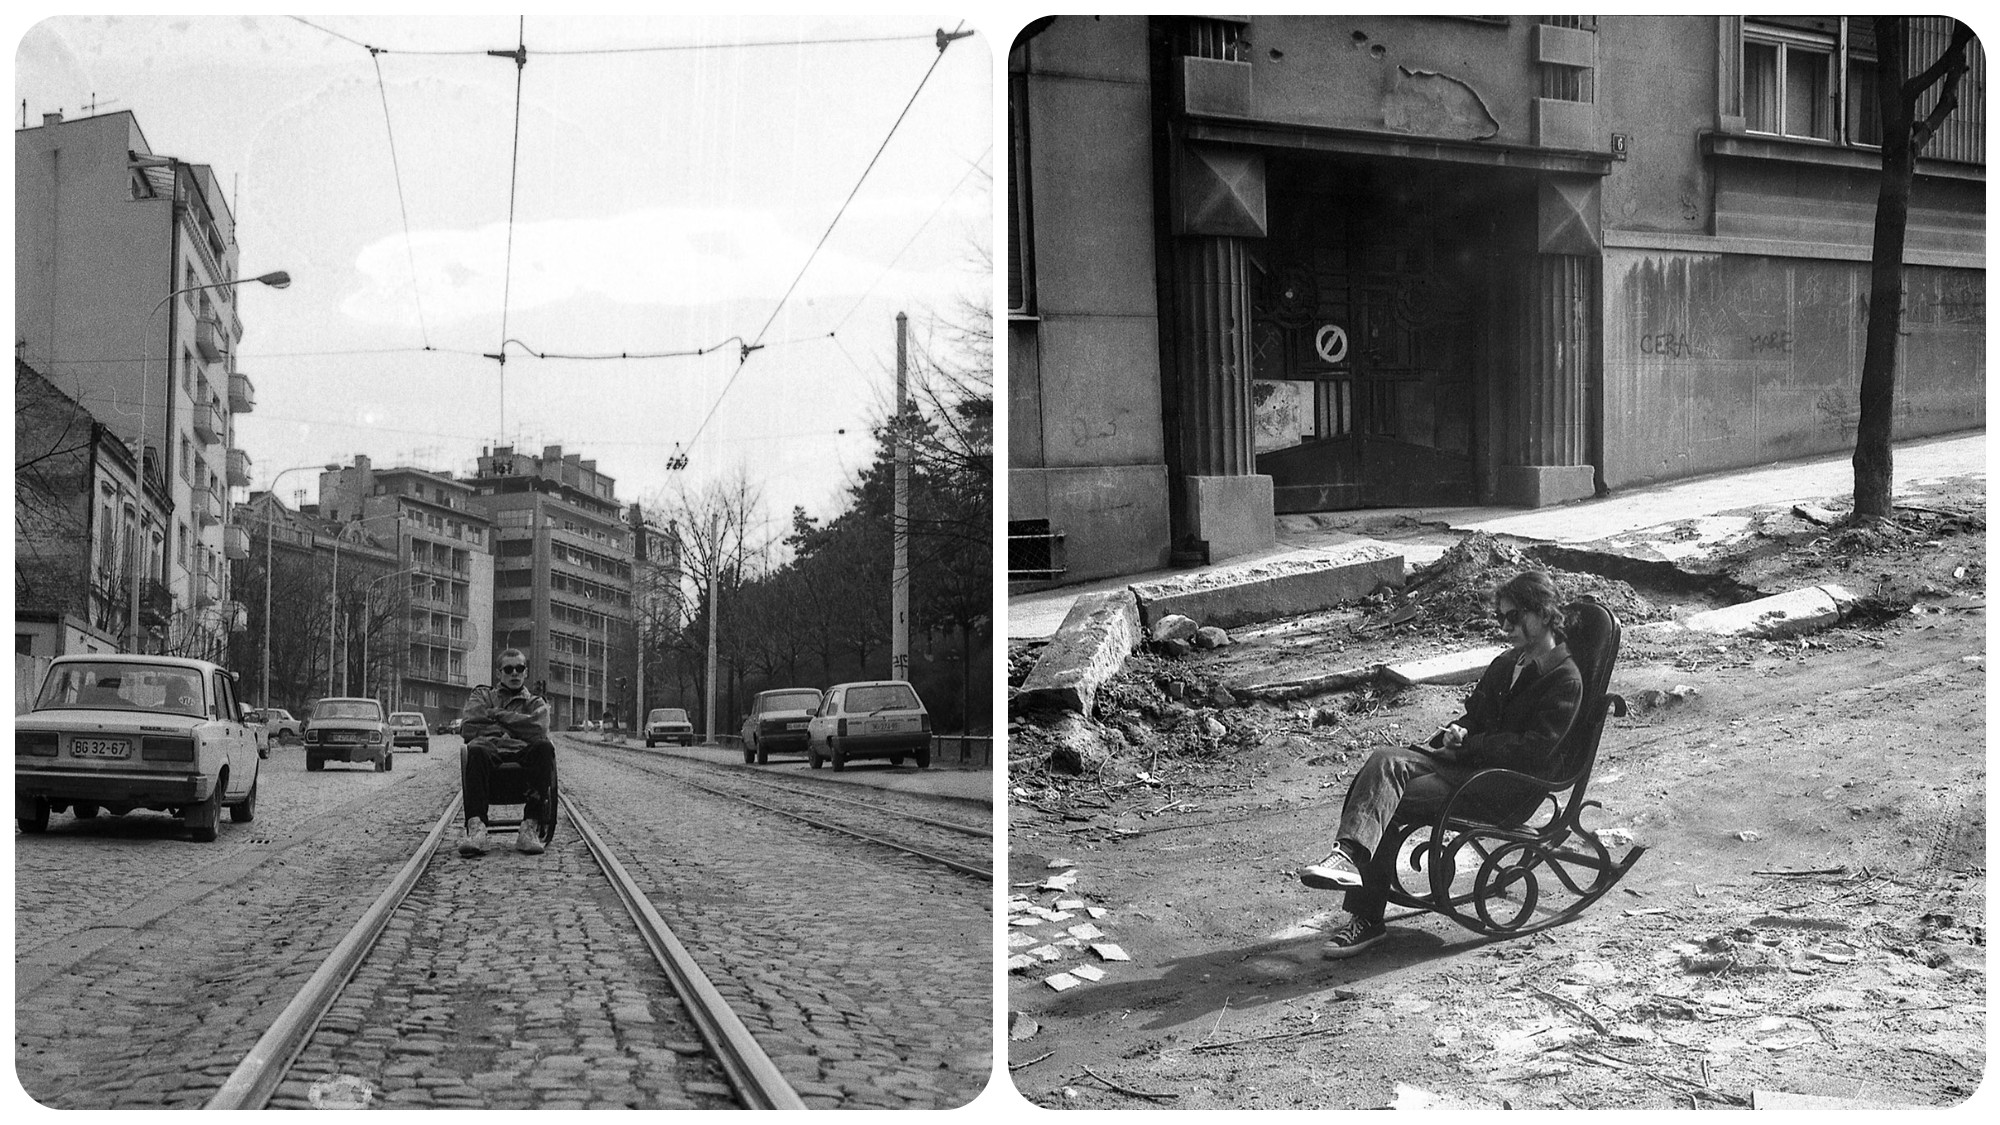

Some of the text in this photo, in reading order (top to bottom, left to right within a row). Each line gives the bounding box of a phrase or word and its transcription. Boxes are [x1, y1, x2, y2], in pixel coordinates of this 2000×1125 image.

[1617, 136, 1624, 151] 6
[75, 741, 126, 755] BG 32-67
